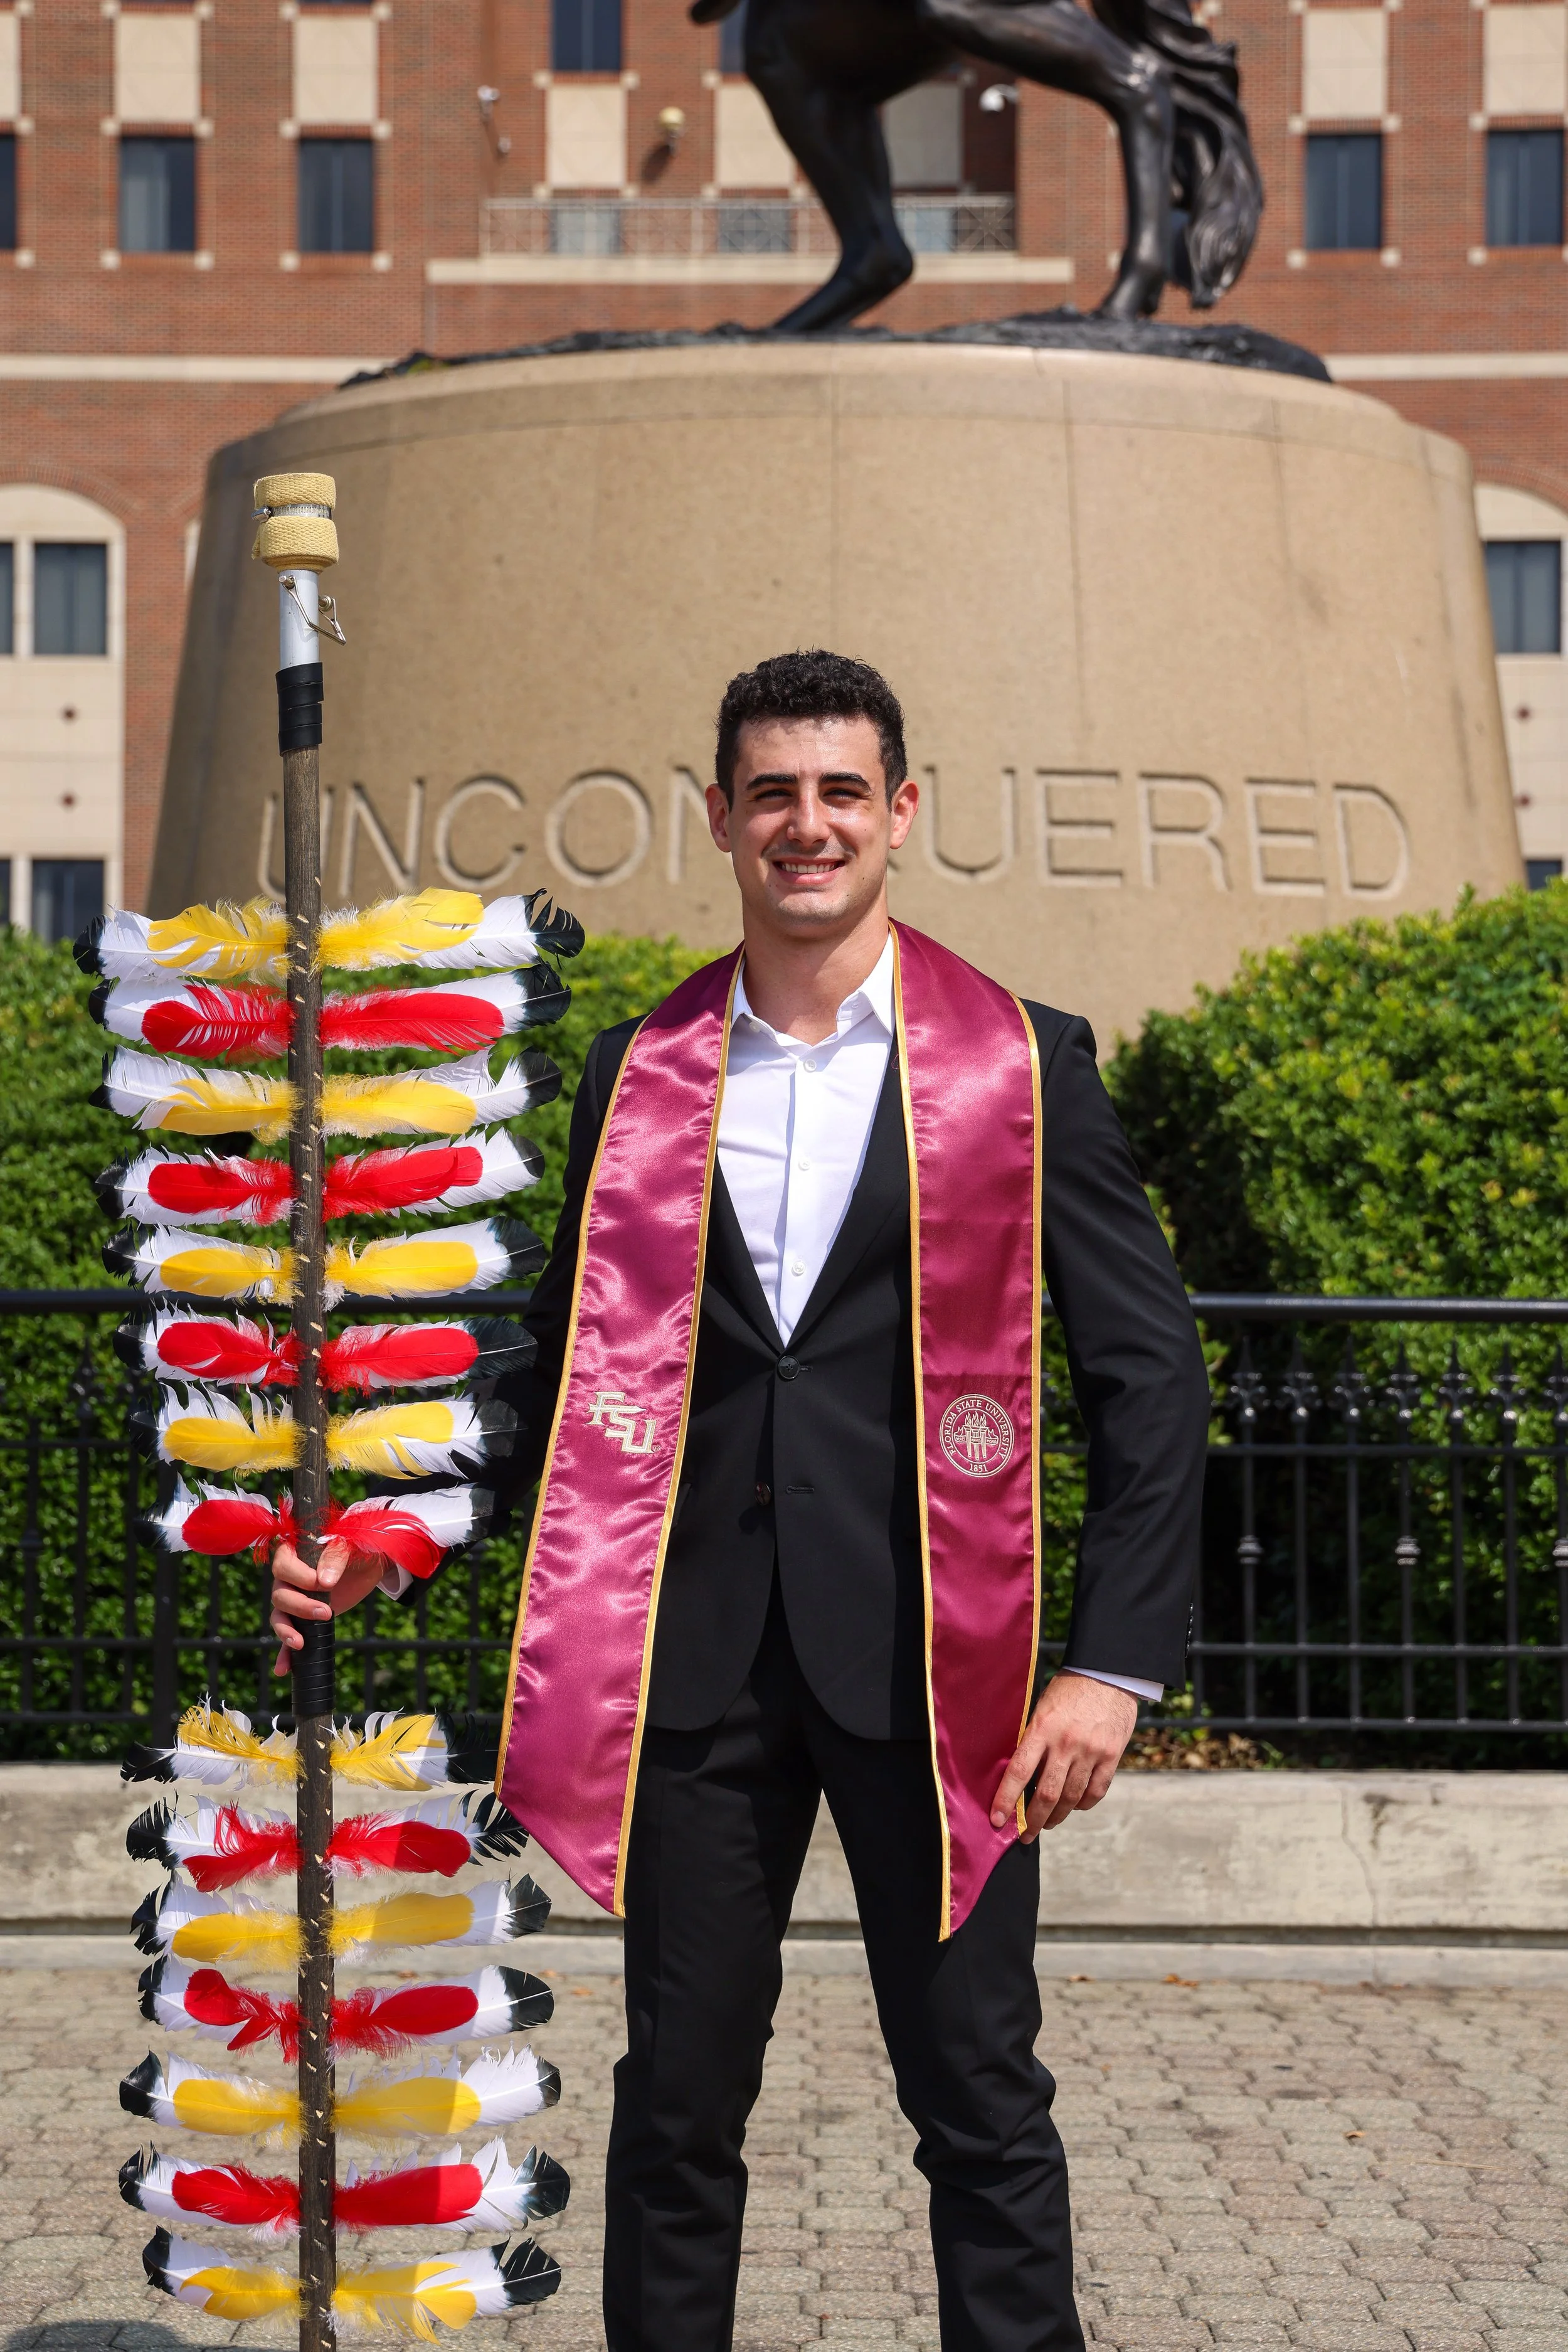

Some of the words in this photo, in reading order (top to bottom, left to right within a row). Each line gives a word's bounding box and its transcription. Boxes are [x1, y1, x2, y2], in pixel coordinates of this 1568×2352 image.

[256, 764, 1411, 903] UNCOUERED
[586, 1392, 656, 1453] FSU
[945, 1412, 957, 1456] FLORIDA
[956, 1400, 982, 1412] STATE
[985, 1403, 1010, 1459] UNIVERSITY
[969, 1464, 988, 1472] 1851
